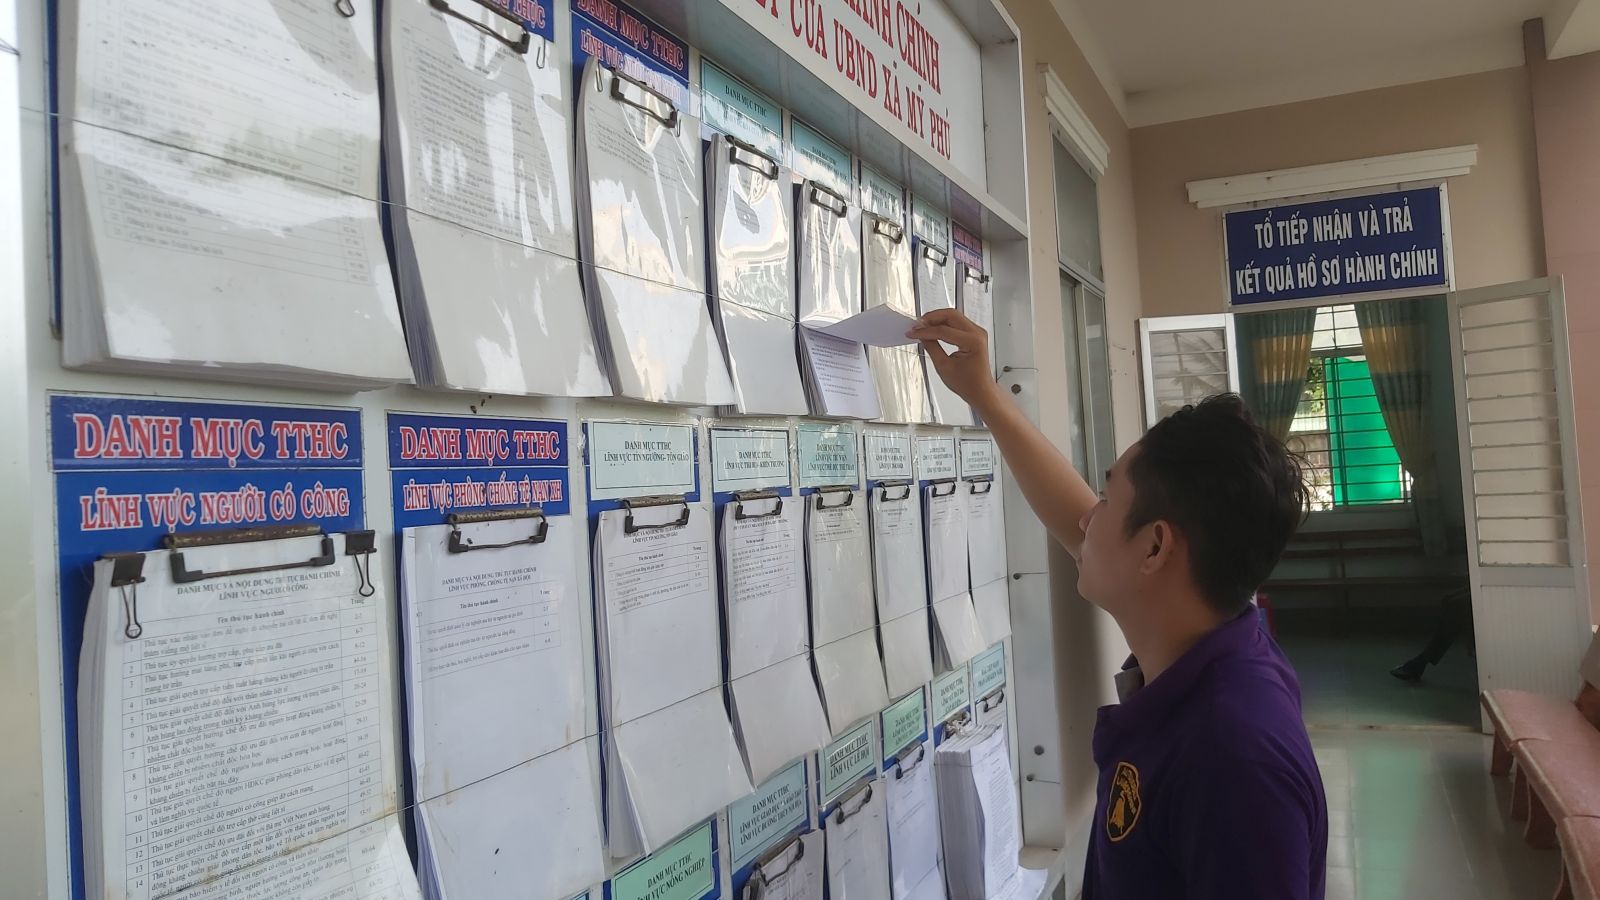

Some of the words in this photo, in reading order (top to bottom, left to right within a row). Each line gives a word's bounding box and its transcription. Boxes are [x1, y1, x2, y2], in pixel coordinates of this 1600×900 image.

[620, 9, 649, 50] MỤC
[652, 30, 684, 71] TTHC
[833, 18, 877, 99] UBND
[896, 2, 941, 95] CHÍNH
[725, 85, 741, 101] DANH
[1255, 210, 1273, 248] TỔ
[1277, 211, 1308, 246] TIẾP
[1313, 209, 1352, 245] NHẬN
[1359, 204, 1380, 237] VÀ
[1383, 197, 1413, 234] TRẢ
[1236, 260, 1261, 295] KẾT
[1265, 257, 1294, 294] QUẢ
[1298, 253, 1317, 289] HỒ
[1322, 255, 1340, 286] SƠ
[1345, 252, 1386, 284] HÀNH
[1390, 245, 1438, 279] CHÍNH
[73, 413, 182, 459] DANH
[190, 418, 265, 467] MỤC
[271, 420, 349, 459] TTHC
[400, 426, 462, 459] DANH
[466, 428, 509, 466] MỤC
[513, 430, 560, 459] TTHC
[604, 452, 618, 461] LĨNH
[619, 452, 631, 463] VỰC
[625, 441, 641, 450] DANH
[643, 442, 655, 451] MỤC
[657, 442, 671, 450] TTHC
[739, 451, 751, 459] DANH
[80, 487, 143, 531] LĨNH
[146, 488, 196, 533] VỰC
[200, 483, 266, 524] NGƯỜI
[270, 482, 296, 520] CÓ
[301, 481, 350, 517] CÔNG
[403, 479, 430, 511] LĨNH
[431, 479, 452, 514] VỰC
[453, 476, 487, 507] PHÒNG
[487, 471, 518, 506] CHỐNG
[519, 474, 530, 507] TỆ
[532, 480, 549, 507] NẠN
[550, 480, 563, 501] XH
[752, 800, 766, 814] DANH
[647, 871, 664, 888] DANH
[665, 861, 677, 878] MỤC
[666, 871, 683, 889] NÔNG
[685, 857, 706, 879] NGHIỆP
